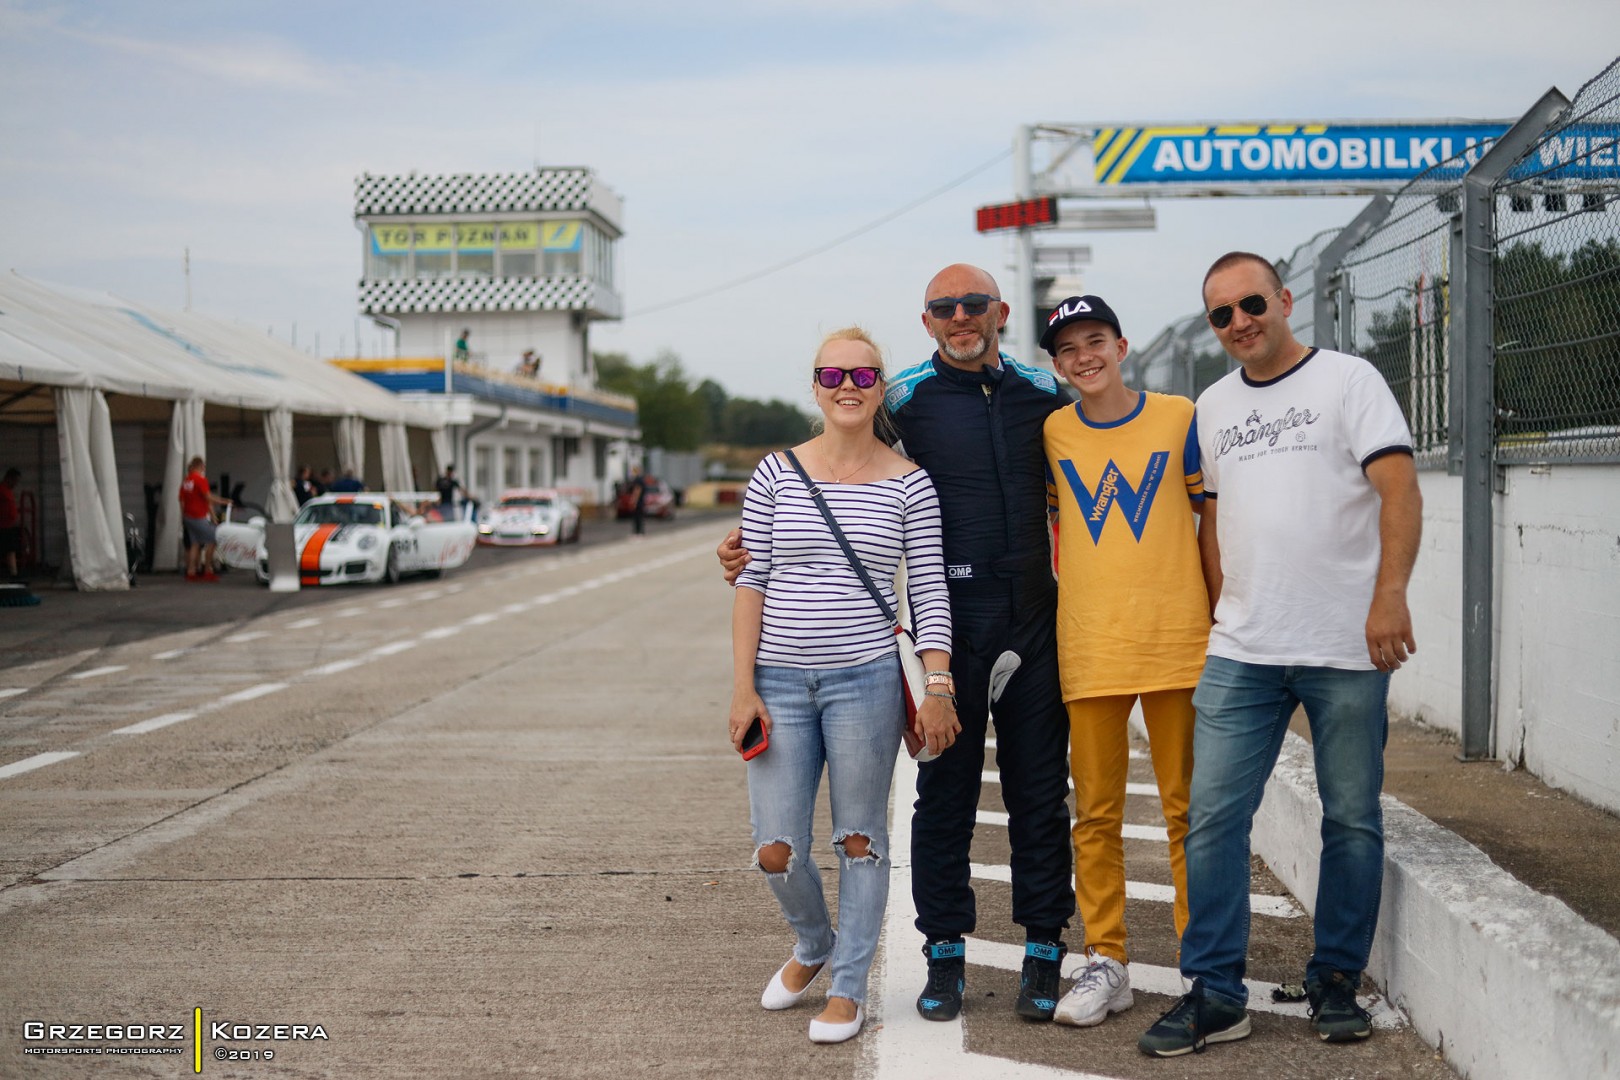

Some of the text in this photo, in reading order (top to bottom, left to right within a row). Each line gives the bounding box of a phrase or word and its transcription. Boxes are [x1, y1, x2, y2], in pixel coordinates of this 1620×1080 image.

[1152, 136, 1620, 171] AUTOMOBILKLU WIE
[1048, 300, 1092, 326] FILA
[889, 385, 909, 402] OMP
[1212, 406, 1320, 461] Wrangler
[1238, 453, 1255, 462] MADE
[1291, 444, 1318, 452] SERVICE
[1089, 468, 1119, 522] Wrangler
[948, 567, 972, 577] OMP
[937, 947, 957, 955] OMP
[1033, 947, 1053, 956] OMP
